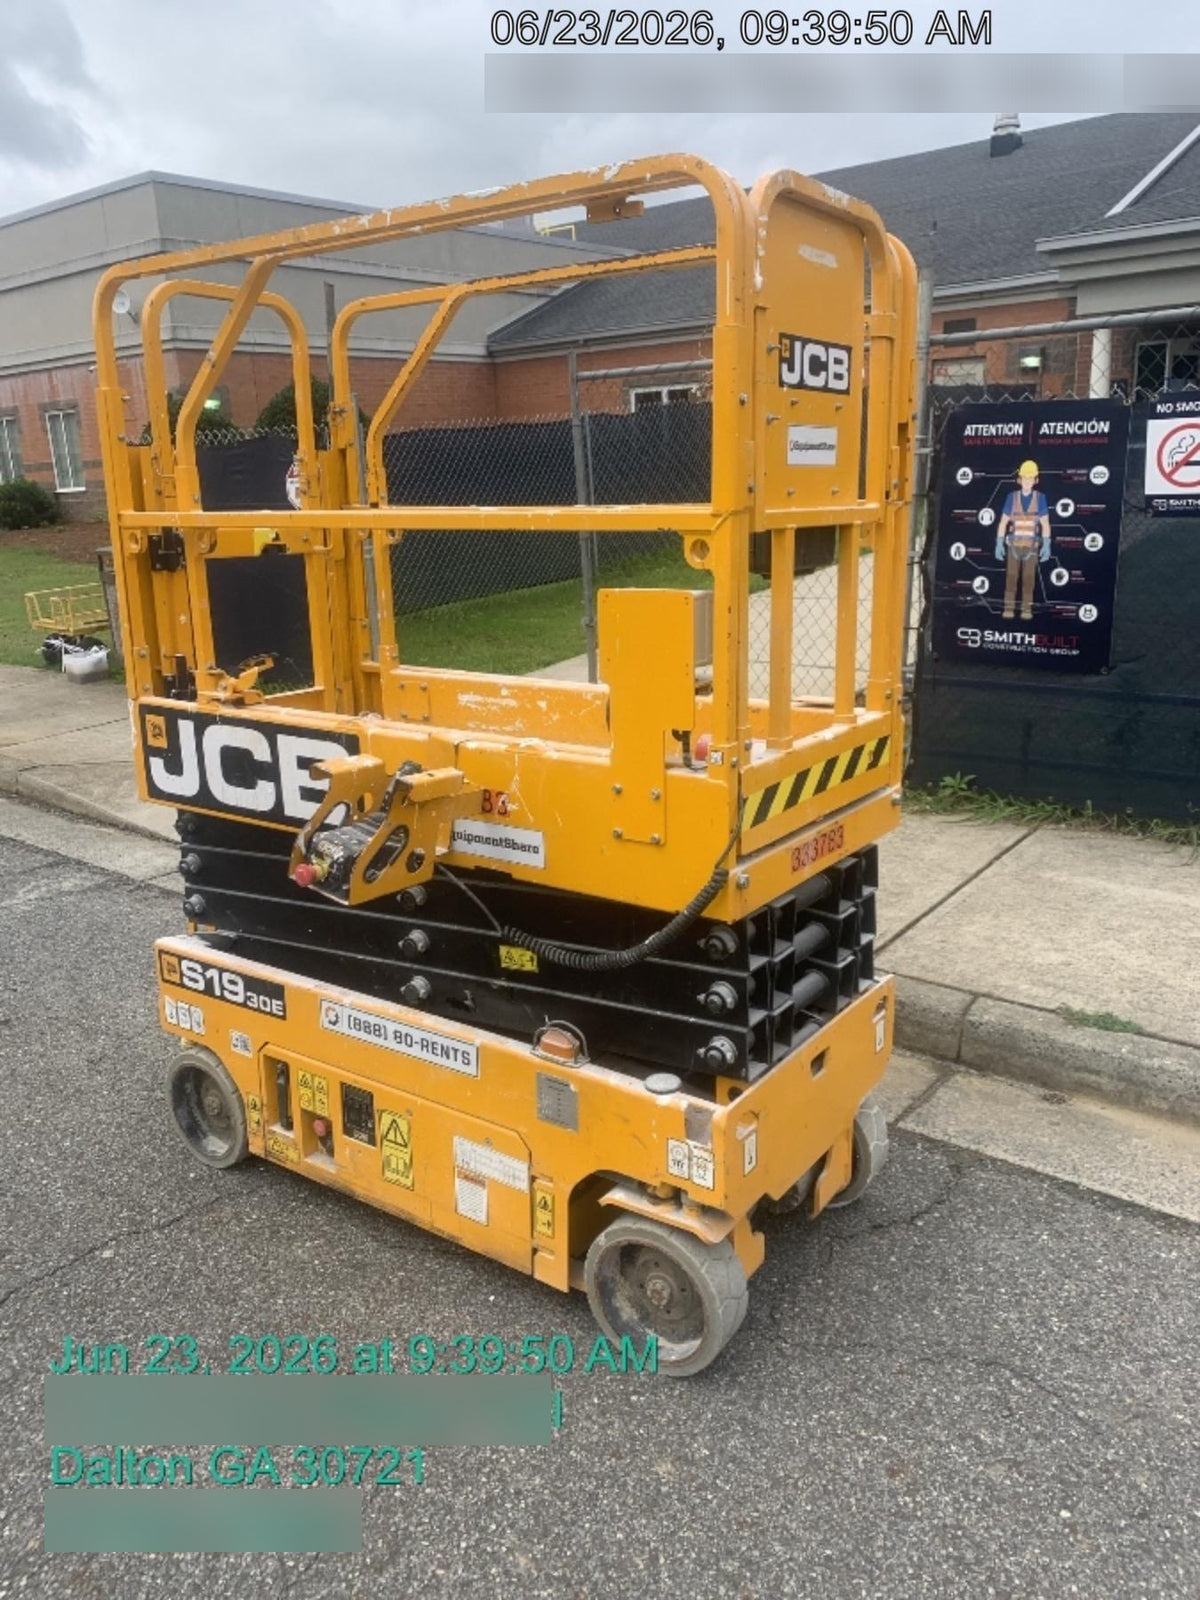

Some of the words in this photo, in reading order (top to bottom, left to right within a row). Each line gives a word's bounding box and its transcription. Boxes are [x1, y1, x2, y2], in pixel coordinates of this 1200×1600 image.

[781, 340, 849, 390] JCB
[1156, 402, 1174, 414] NO
[964, 423, 1024, 437] ATTENTION
[1039, 417, 1111, 435] ATENCIÓN
[982, 642, 1048, 654] CONSTRUCTION
[1049, 648, 1080, 656] GROUP
[149, 718, 350, 828] JCB
[451, 829, 540, 855] quipmentShare
[180, 958, 246, 1005] S19
[392, 1028, 472, 1066] 80-RENTS
